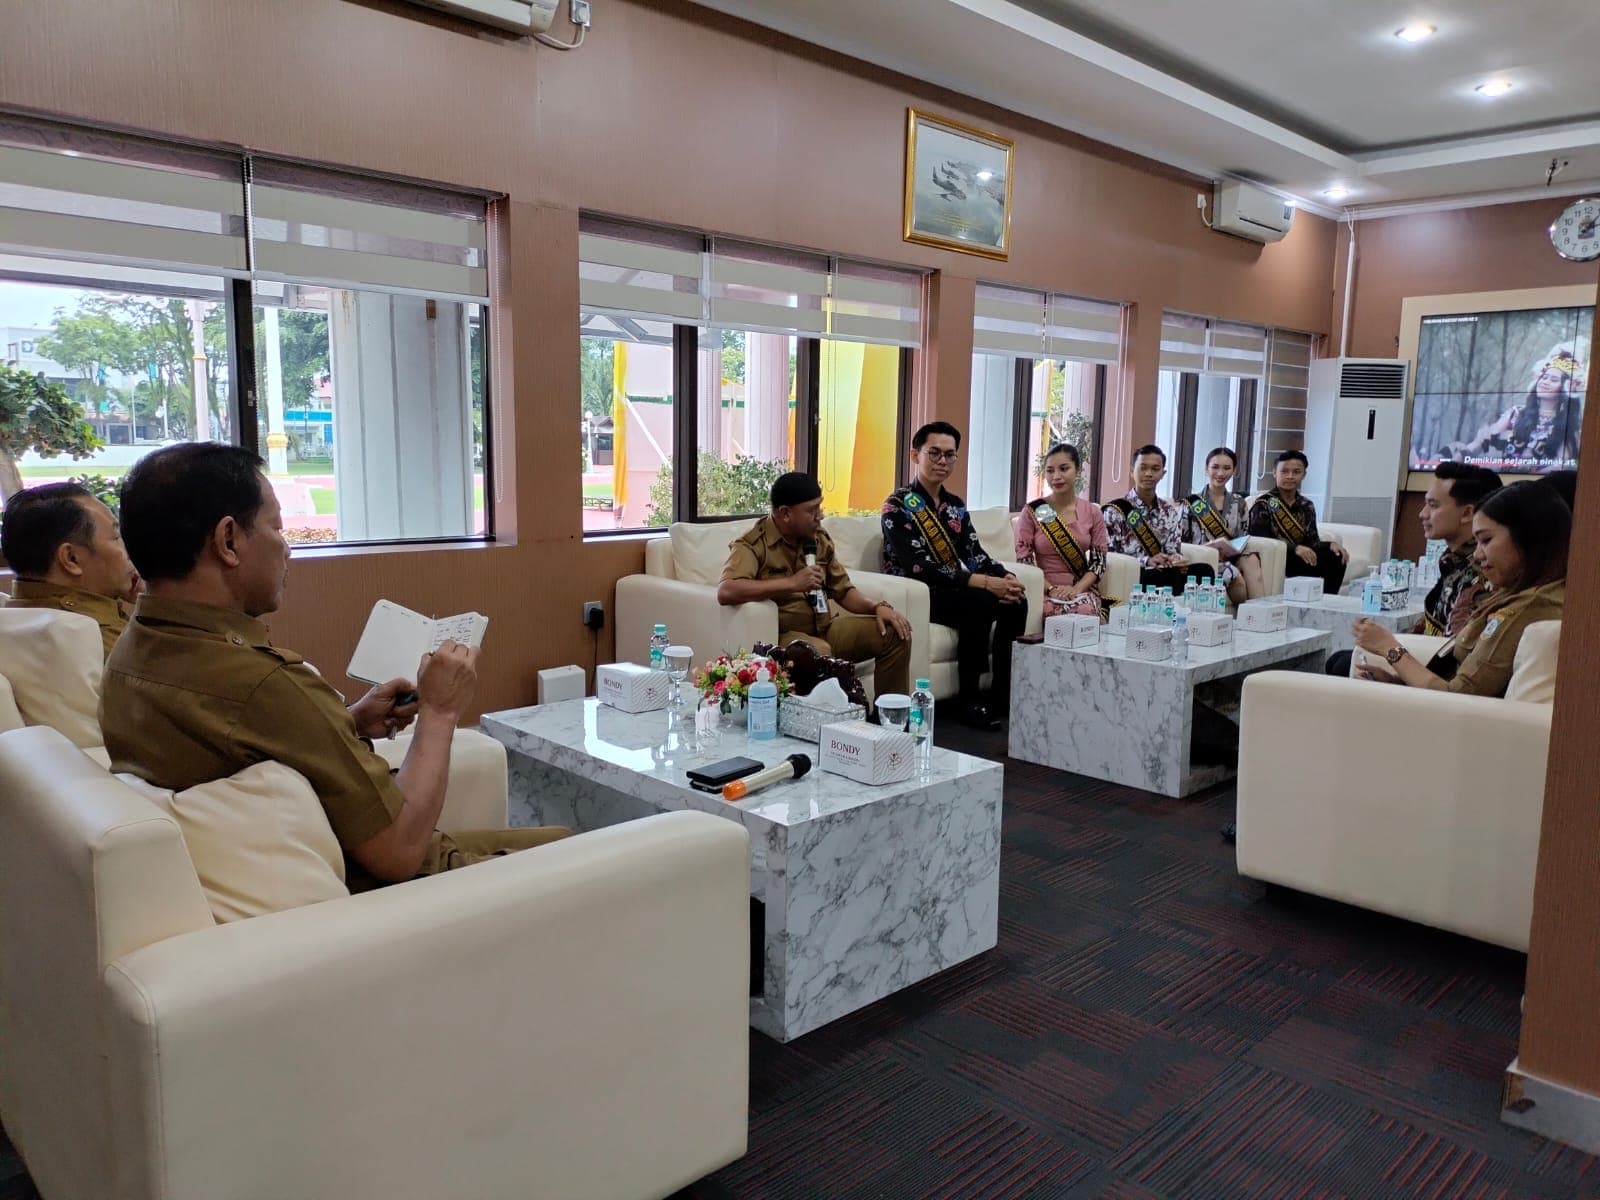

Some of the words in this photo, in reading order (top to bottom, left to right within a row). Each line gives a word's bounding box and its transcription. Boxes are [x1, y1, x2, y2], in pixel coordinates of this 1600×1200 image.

[908, 496, 921, 508] 01
[603, 677, 623, 690] BONDY
[831, 739, 861, 756] BONDY
